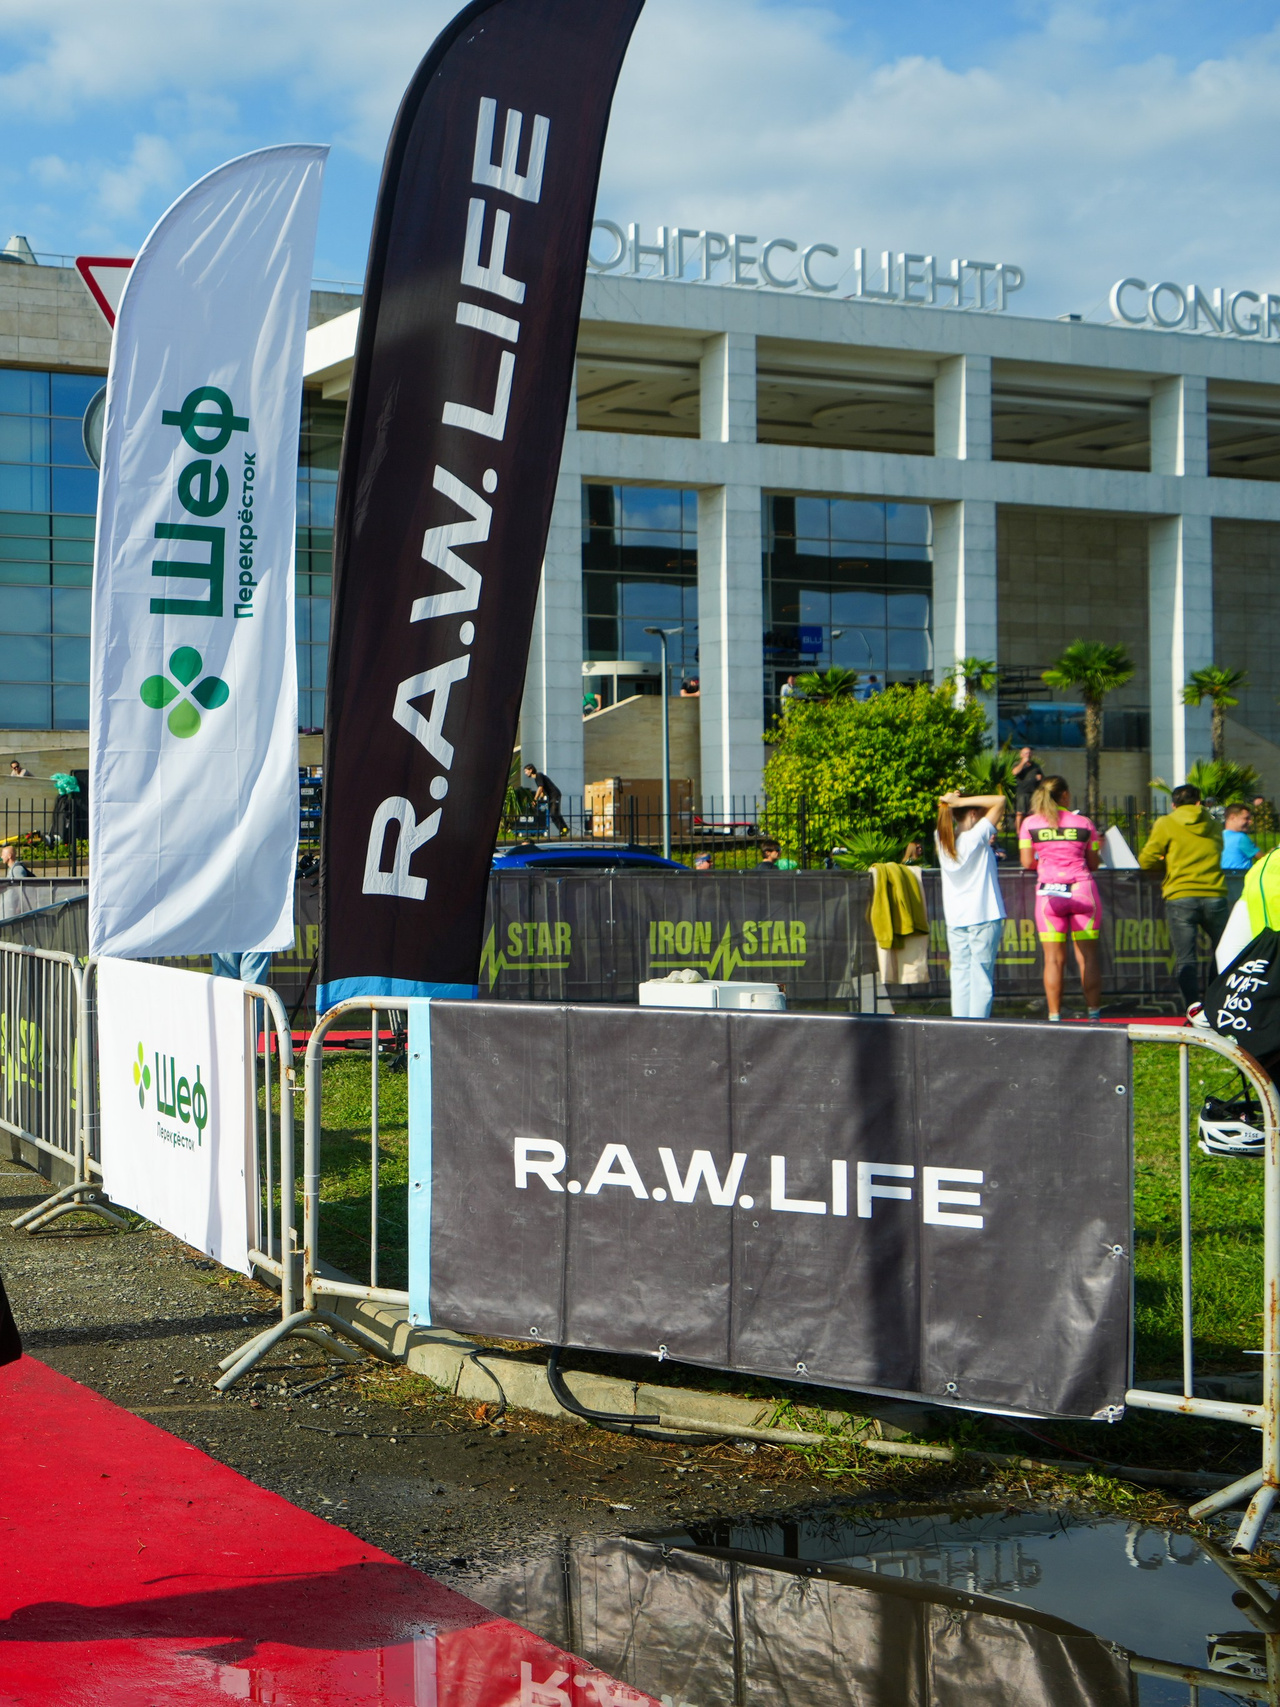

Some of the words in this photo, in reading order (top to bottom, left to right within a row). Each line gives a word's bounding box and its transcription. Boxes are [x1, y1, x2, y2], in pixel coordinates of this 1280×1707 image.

[854, 247, 1025, 311] ЦЕНТР
[150, 386, 250, 617] Шеф
[362, 96, 551, 900] R.A.W.LIFE
[234, 451, 258, 619] Перекрёсток
[507, 922, 571, 957] STAR
[649, 920, 711, 955] IRON
[742, 920, 807, 955] STAR
[1115, 918, 1171, 951] IRON
[1217, 1009, 1252, 1031] DO.
[1223, 992, 1252, 1011] YOU
[155, 1051, 208, 1147] Шеф
[157, 1121, 196, 1152] Перекрёсток
[514, 1136, 984, 1229] R.A.W.LIFE
